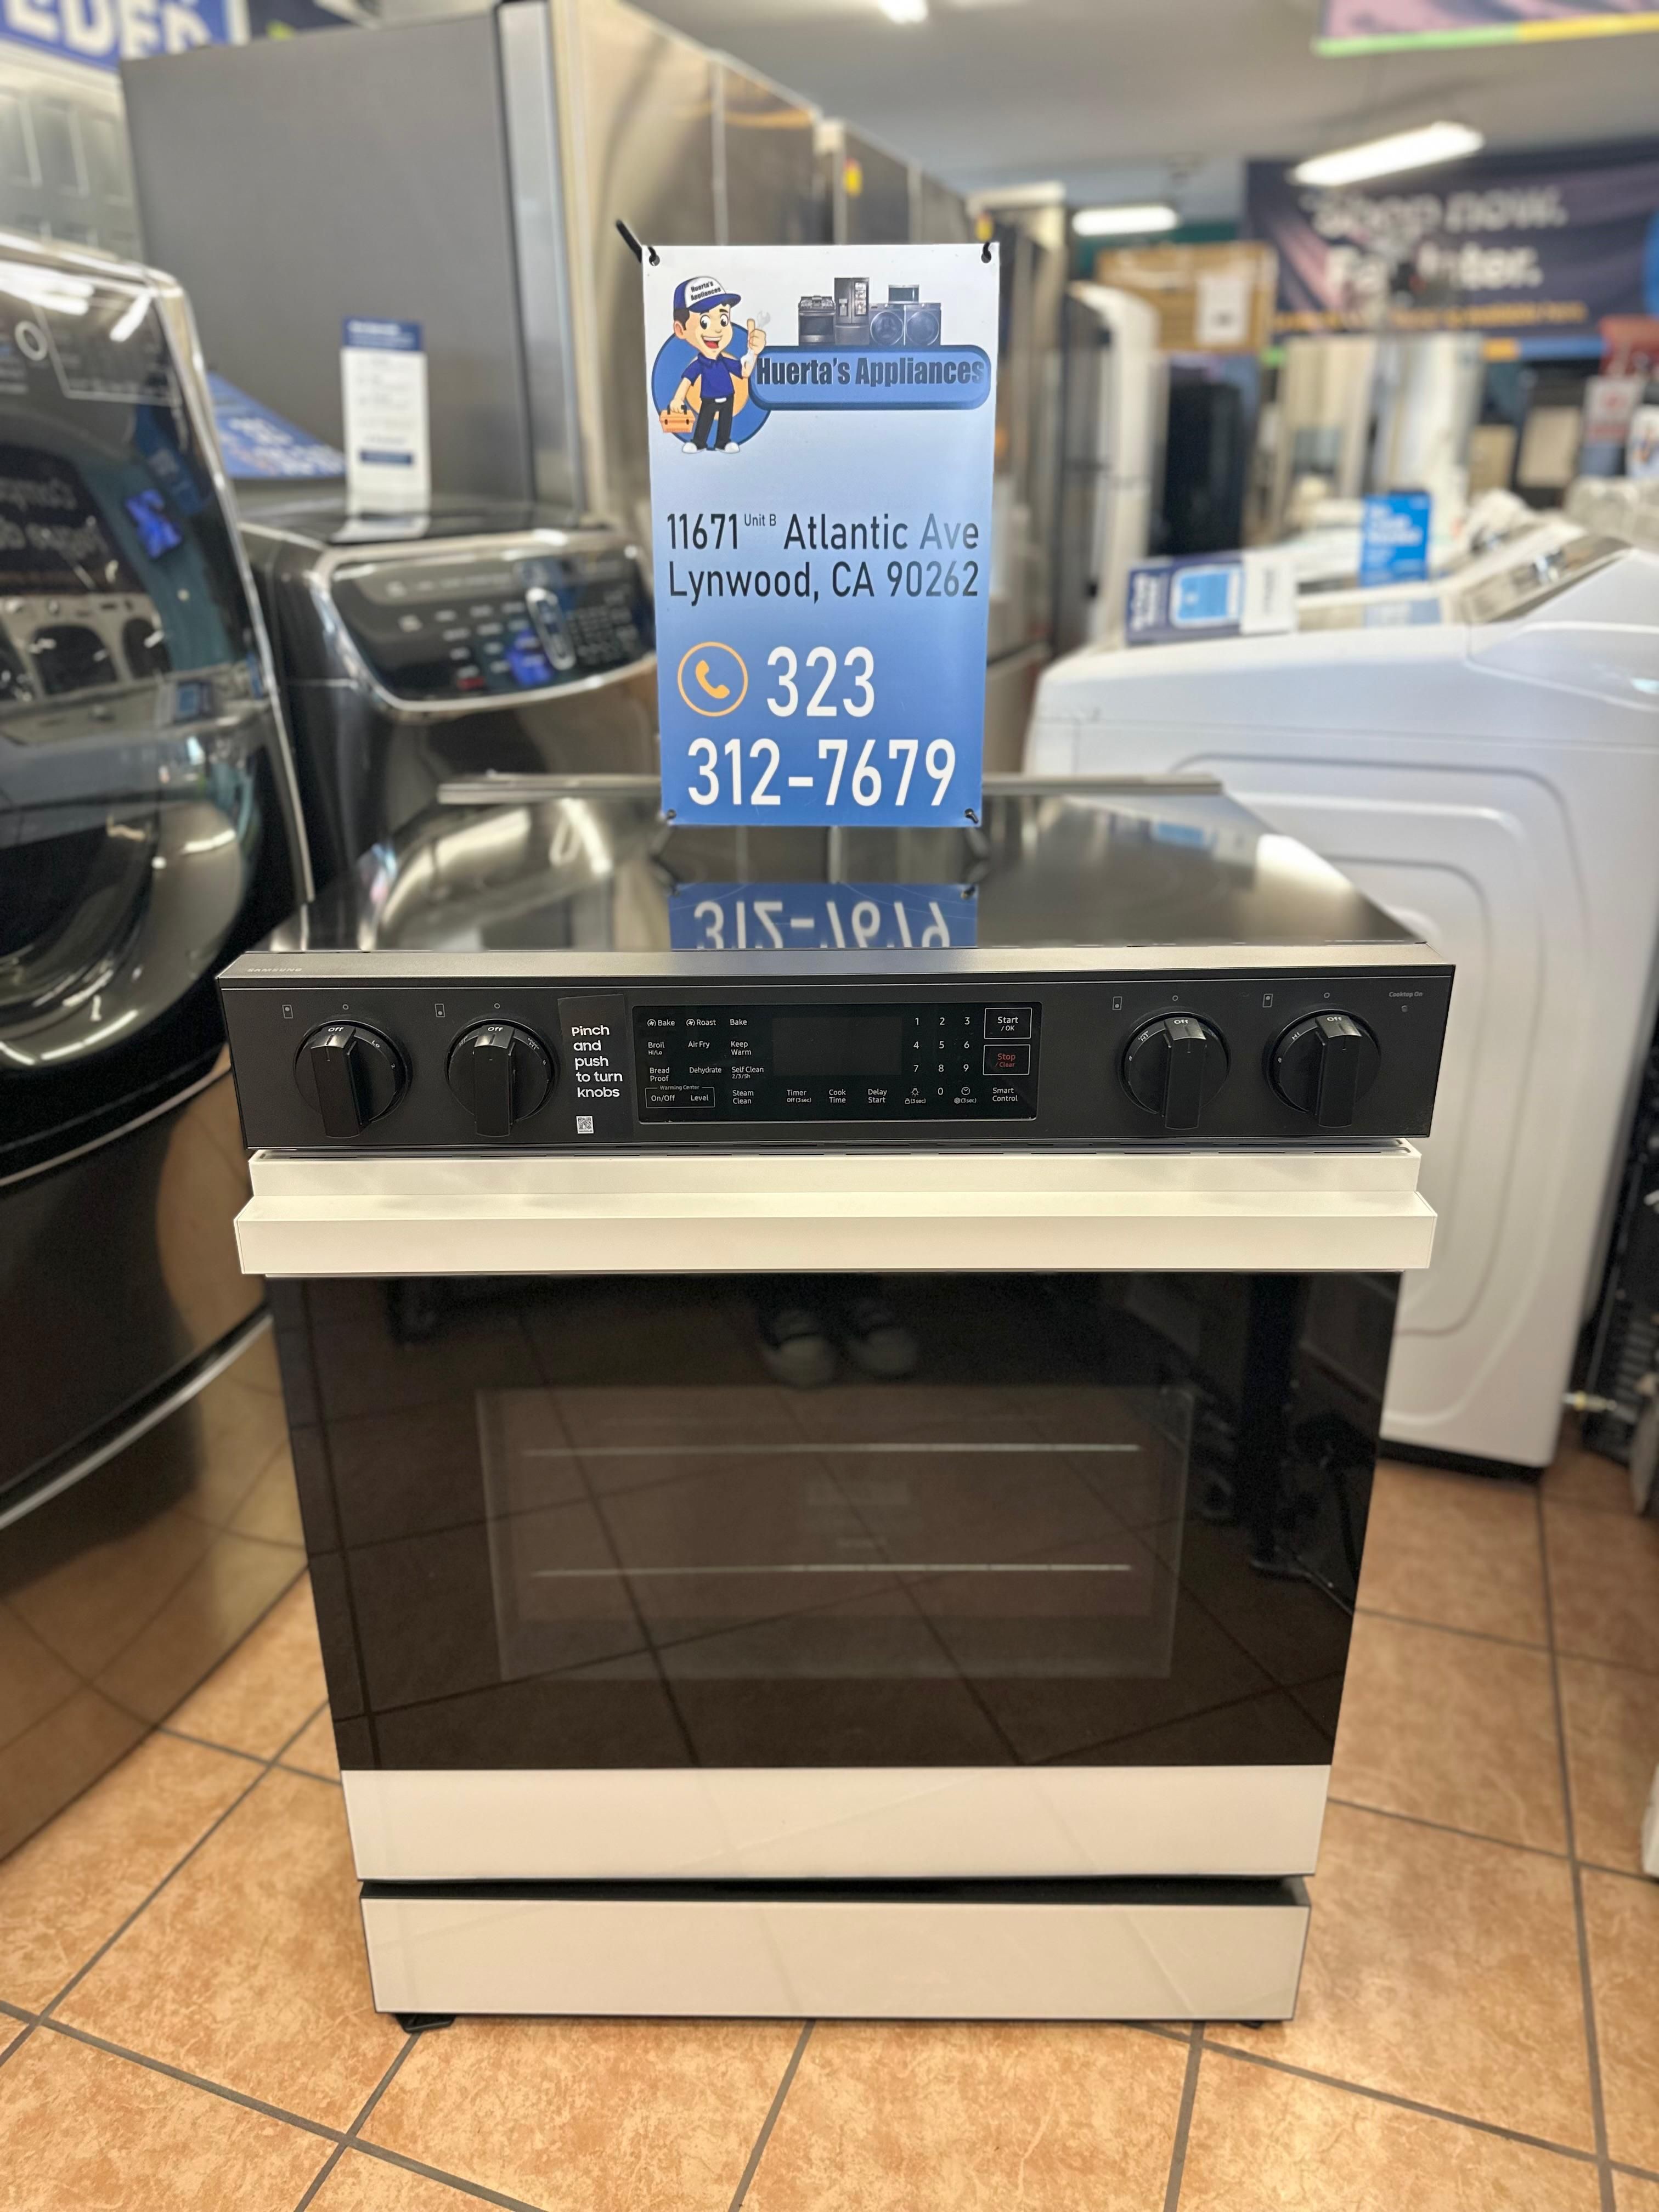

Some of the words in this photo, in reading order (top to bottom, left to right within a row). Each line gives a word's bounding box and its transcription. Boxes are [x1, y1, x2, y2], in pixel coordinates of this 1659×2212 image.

[690, 281, 714, 292] Huerta's
[690, 287, 721, 301] Appliances
[757, 357, 851, 385] Huerta's
[855, 357, 984, 387] Appliances
[666, 513, 738, 550] 11671
[743, 514, 765, 527] Unit
[769, 514, 777, 527] B
[783, 512, 908, 550] Atlantic
[919, 512, 979, 550] Ave
[669, 561, 819, 606] Lynwood,
[832, 561, 875, 597] CA
[887, 560, 979, 597] 90262
[766, 646, 875, 718] 323
[687, 737, 956, 806] 312-7679
[915, 1017, 919, 1025] 1
[939, 1017, 945, 1025] 2
[964, 1017, 970, 1025] 3
[571, 1025, 610, 1036] Pinch
[573, 1040, 602, 1051] and
[699, 1041, 710, 1049] Fry
[731, 1041, 748, 1049] Keep
[939, 1041, 945, 1049] 5
[964, 1041, 970, 1049] 6
[997, 1053, 1015, 1062] Stop
[574, 1056, 609, 1070] push
[689, 1066, 722, 1075] Dehydrate
[913, 1064, 919, 1073] 7
[938, 1064, 944, 1073] 8
[963, 1064, 969, 1072] 9
[575, 1071, 591, 1082] to
[593, 1071, 623, 1082] turn
[577, 1086, 620, 1098] knobs
[938, 1087, 944, 1096] 0
